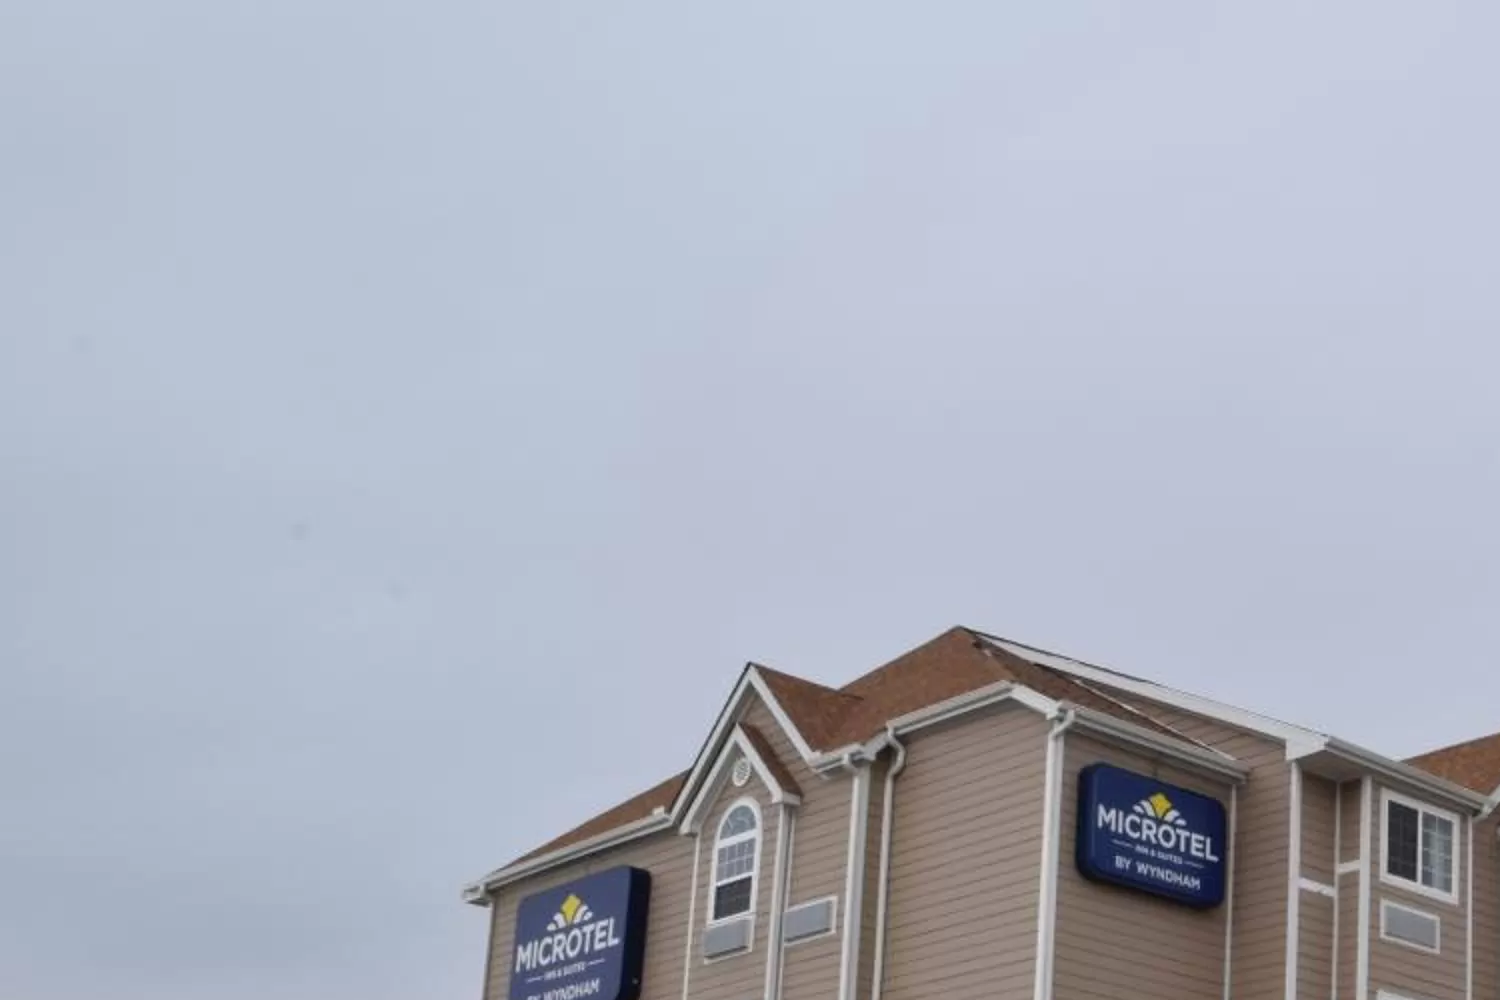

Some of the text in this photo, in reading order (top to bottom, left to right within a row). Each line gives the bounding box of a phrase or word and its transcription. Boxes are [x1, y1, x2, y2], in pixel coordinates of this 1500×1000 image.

[1097, 804, 1219, 862] MICROTEL
[1115, 855, 1201, 890] BY WYNDHAM
[515, 917, 620, 973] MICROTEL
